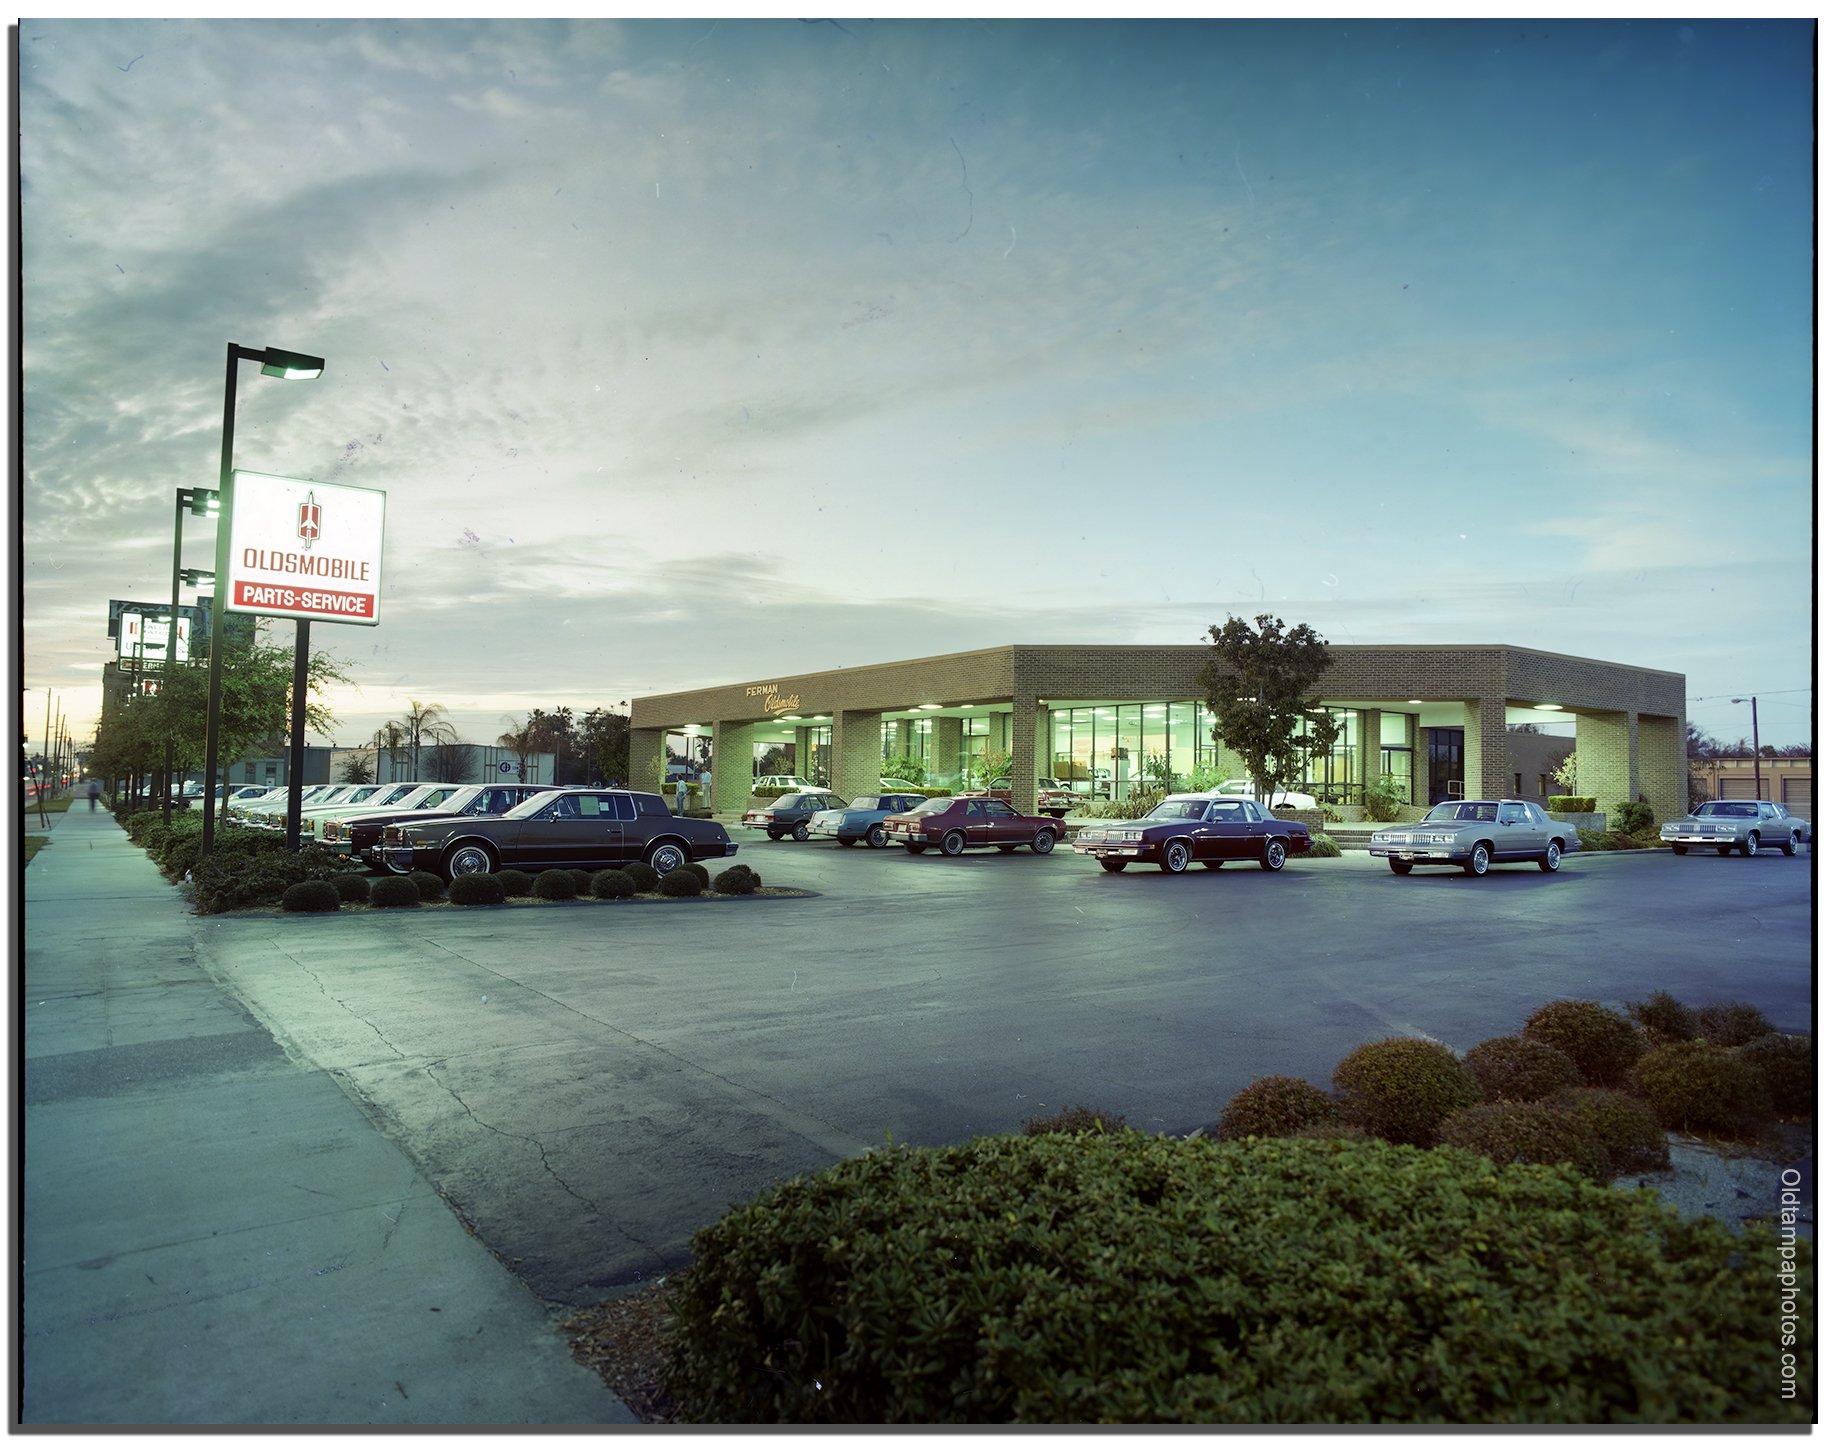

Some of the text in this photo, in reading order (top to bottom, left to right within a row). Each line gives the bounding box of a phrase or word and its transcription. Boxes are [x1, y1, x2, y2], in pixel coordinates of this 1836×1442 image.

[243, 548, 370, 582] OLDSMOBILE
[242, 585, 367, 613] PARTS-SERVICE
[746, 684, 778, 697] FERMAN
[764, 694, 800, 713] Oldsmobile
